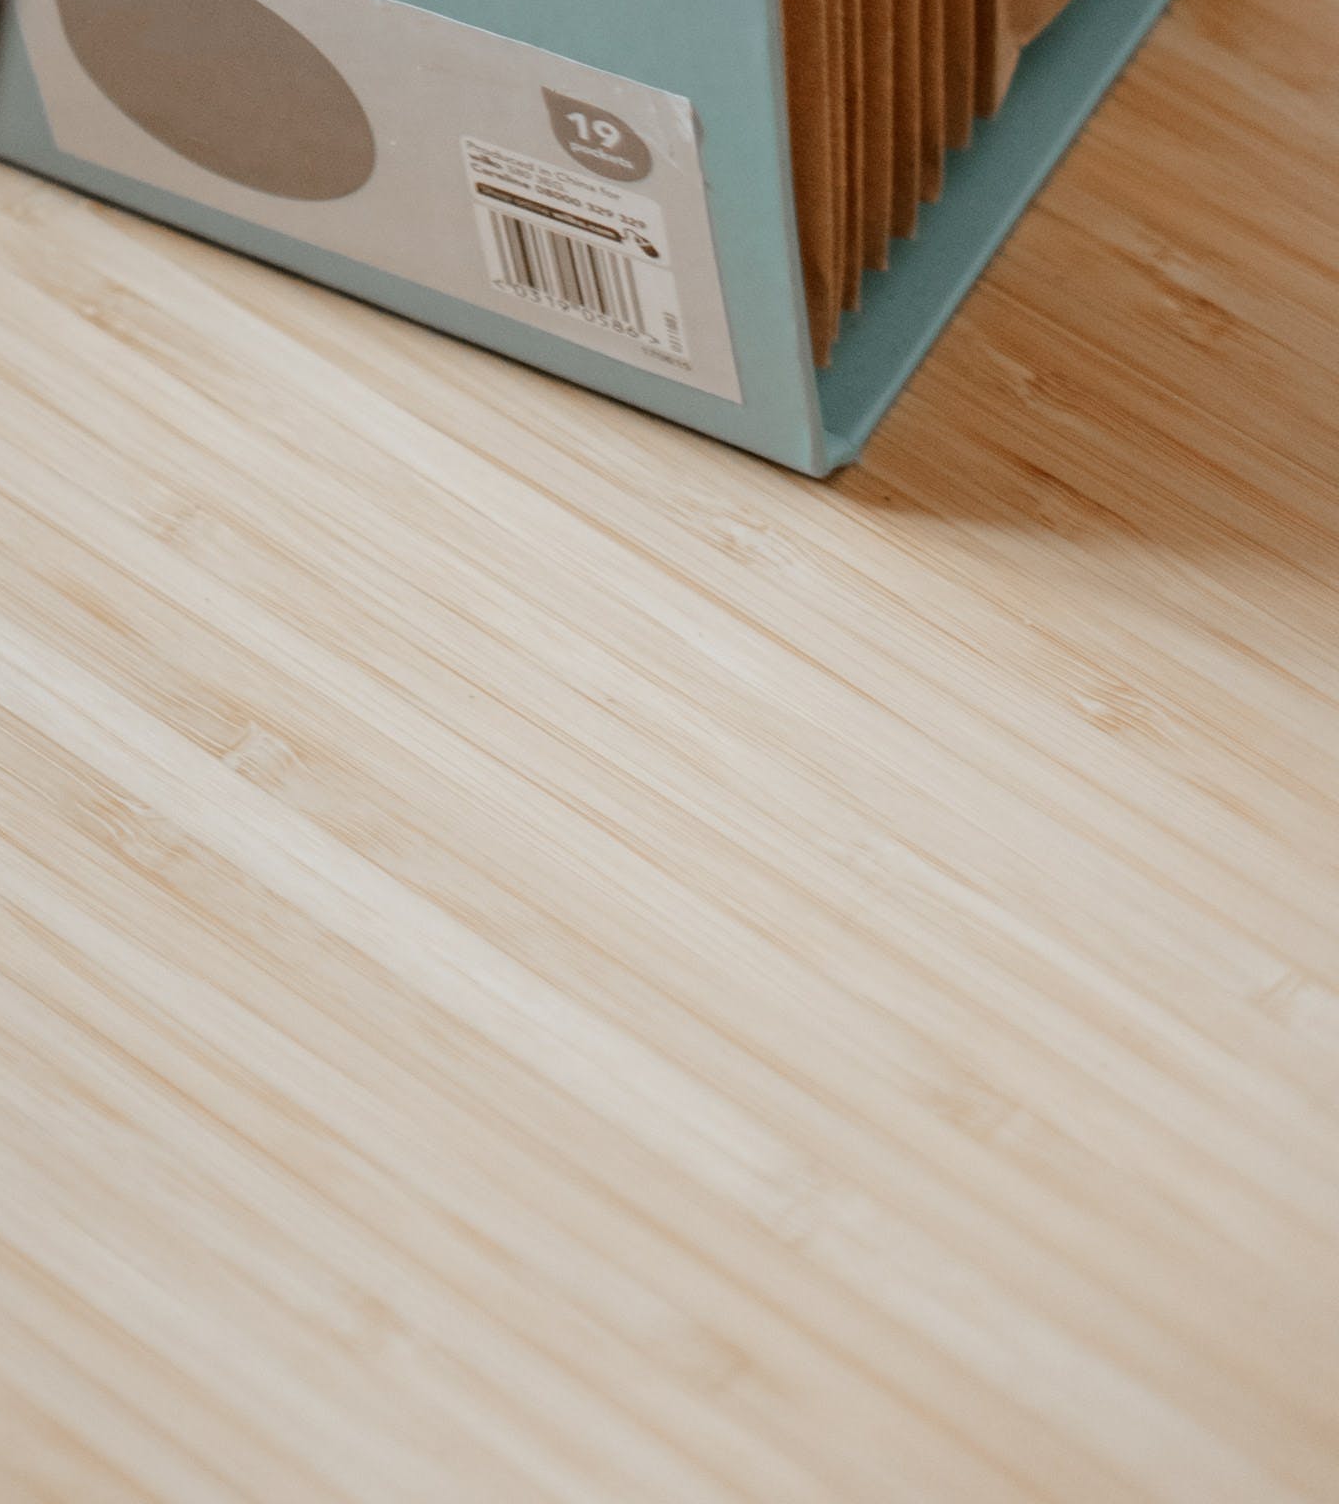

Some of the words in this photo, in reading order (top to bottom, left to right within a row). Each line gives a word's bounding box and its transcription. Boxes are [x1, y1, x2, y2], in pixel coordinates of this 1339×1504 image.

[566, 112, 621, 147] 19
[465, 140, 535, 171] Produced
[538, 166, 551, 176] in
[555, 172, 596, 192] China
